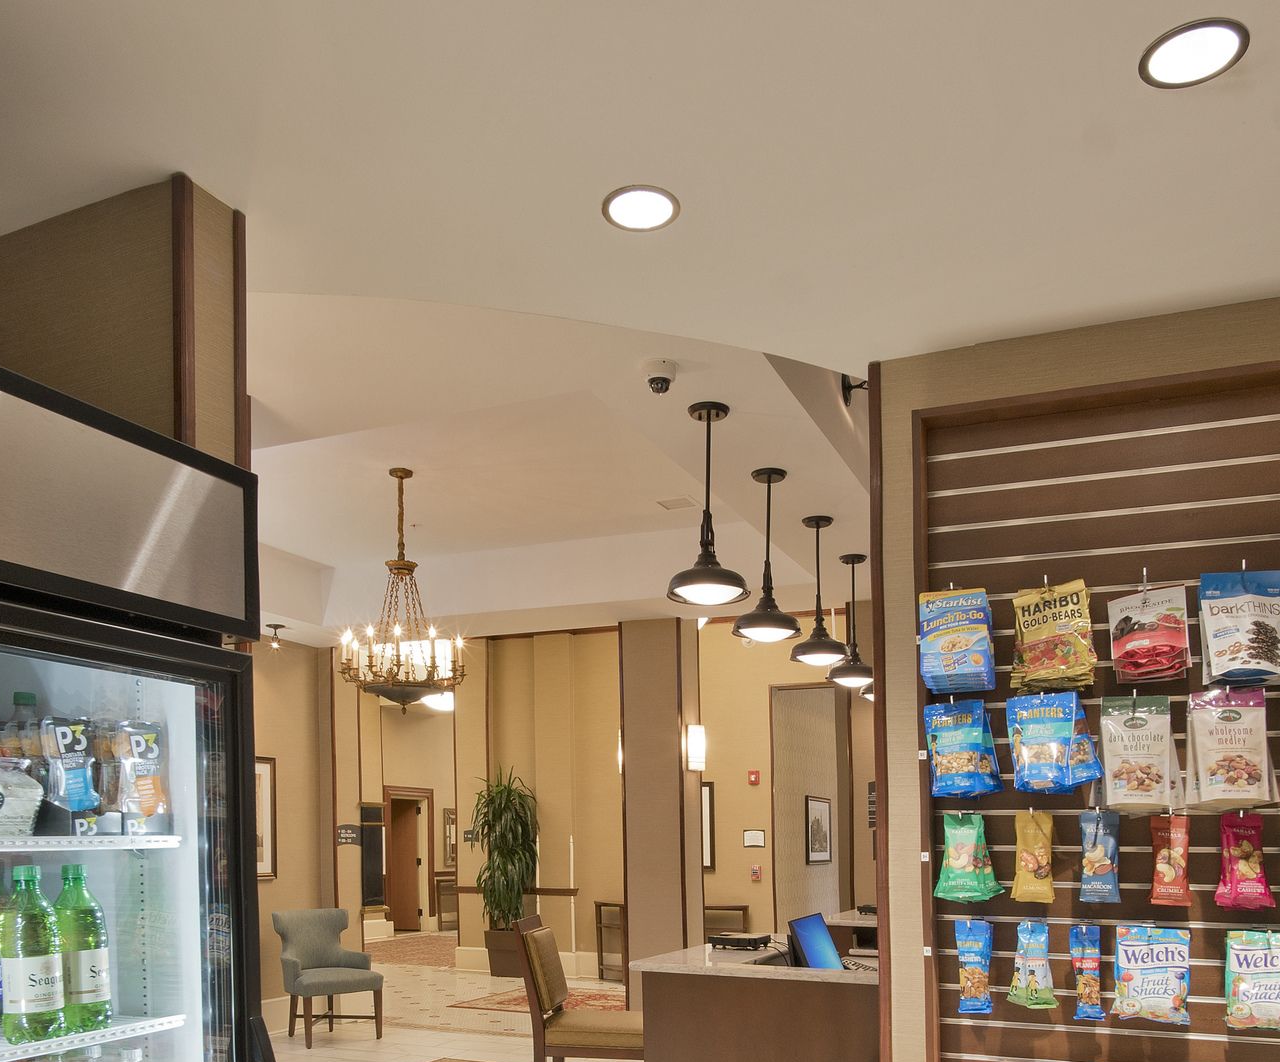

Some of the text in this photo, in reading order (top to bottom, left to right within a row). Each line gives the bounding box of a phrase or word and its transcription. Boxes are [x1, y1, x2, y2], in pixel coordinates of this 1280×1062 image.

[935, 596, 982, 609] StarKist
[1021, 592, 1080, 618] HARIBO
[1209, 601, 1280, 618] barkTHINS
[922, 612, 984, 632] Lunch To-Go
[1022, 609, 1083, 629] GOLD-BEARS
[1017, 707, 1063, 719] PLANTERS
[932, 714, 972, 728] PLANTERS
[55, 724, 88, 753] P3
[1108, 732, 1164, 743] dark chocolate
[1208, 726, 1253, 736] wholesome
[130, 734, 159, 759] P3
[1124, 742, 1151, 753] medley
[1217, 735, 1246, 746] medley
[74, 817, 97, 836] P3
[127, 818, 146, 836] P3
[1123, 946, 1186, 964] Welch's
[1140, 977, 1171, 988] Fruit
[1132, 986, 1176, 998] Snacks
